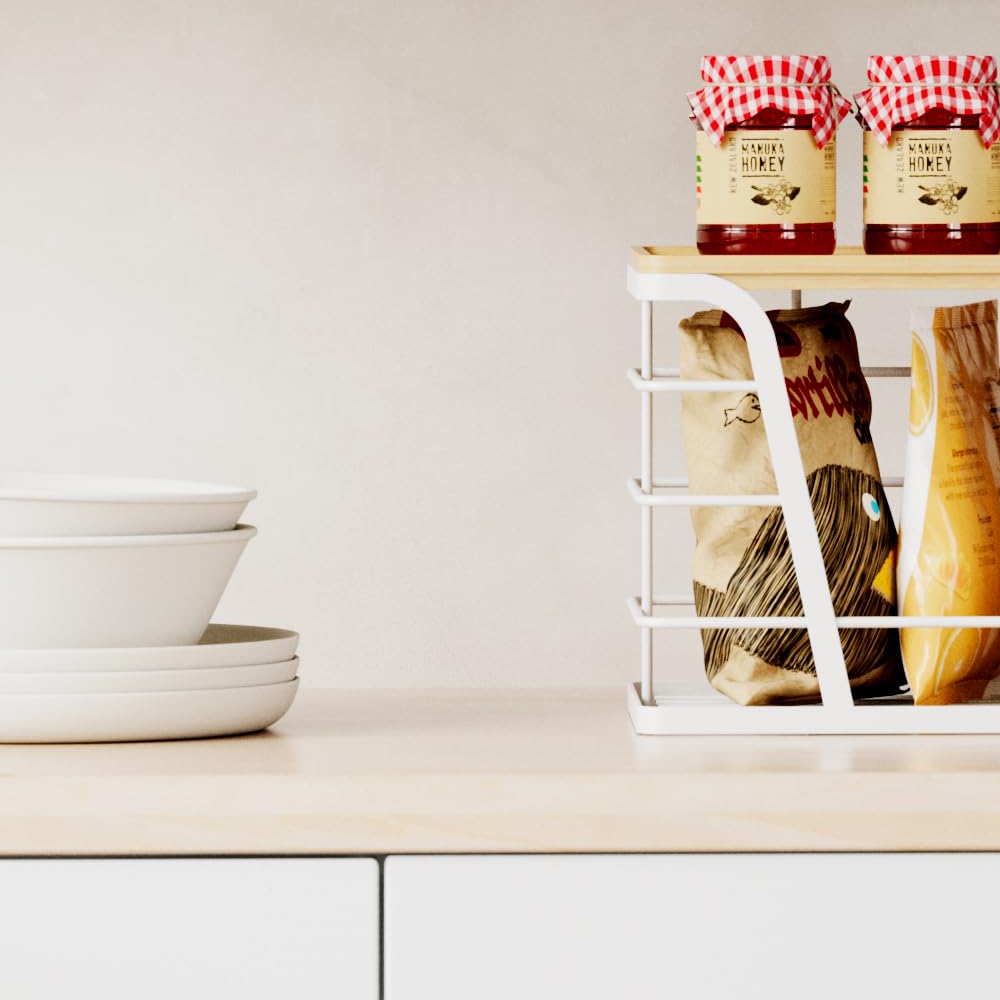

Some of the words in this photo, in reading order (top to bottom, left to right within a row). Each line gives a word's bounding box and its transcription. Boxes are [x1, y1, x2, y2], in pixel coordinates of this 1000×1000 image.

[741, 143, 785, 154] MANUKA
[908, 143, 952, 154] MANUKA
[741, 156, 785, 172] HONEY
[908, 156, 952, 172] HONEY
